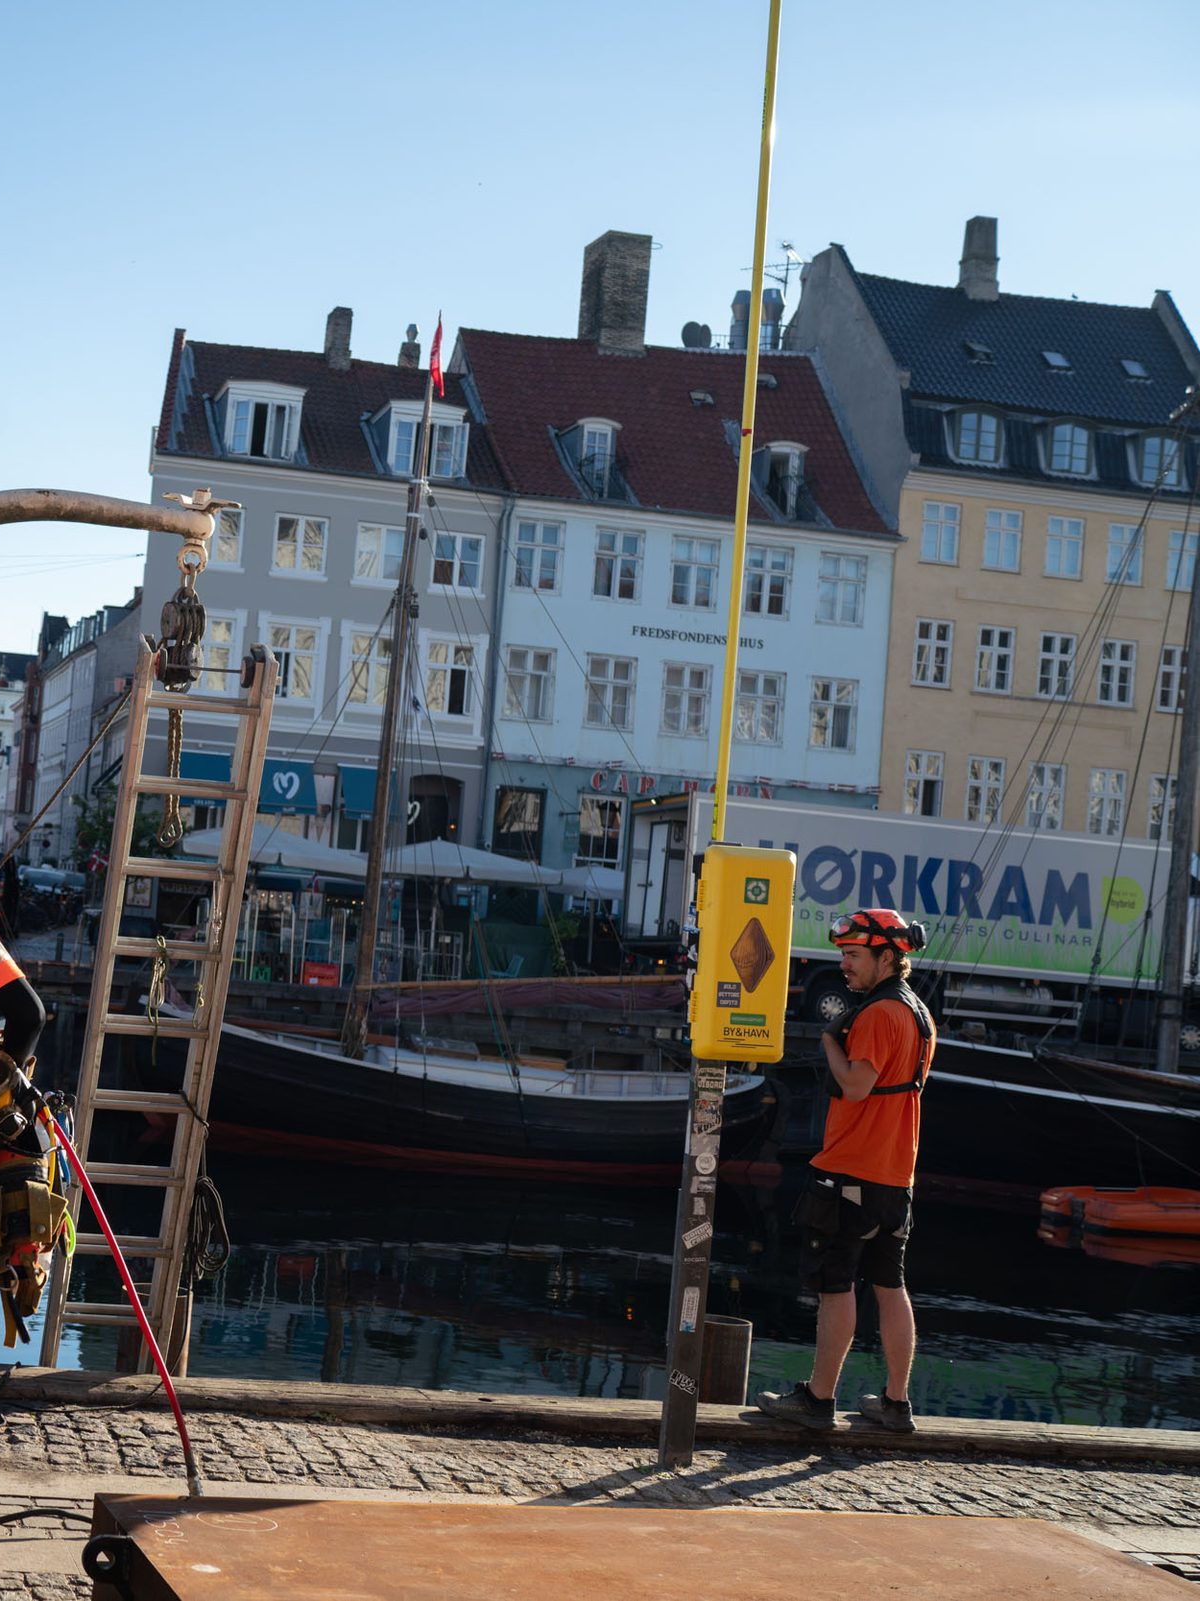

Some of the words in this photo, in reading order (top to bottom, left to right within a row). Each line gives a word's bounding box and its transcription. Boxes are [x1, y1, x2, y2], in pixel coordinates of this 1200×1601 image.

[632, 625, 727, 645] FREDSFONDENS
[740, 637, 764, 649] HUS
[591, 770, 655, 794] CAP
[759, 840, 1093, 930] ØRKRAM
[921, 920, 988, 937] CHEFS
[1003, 928, 1093, 947] CULINAR
[723, 1026, 770, 1038] BY&HAVN
